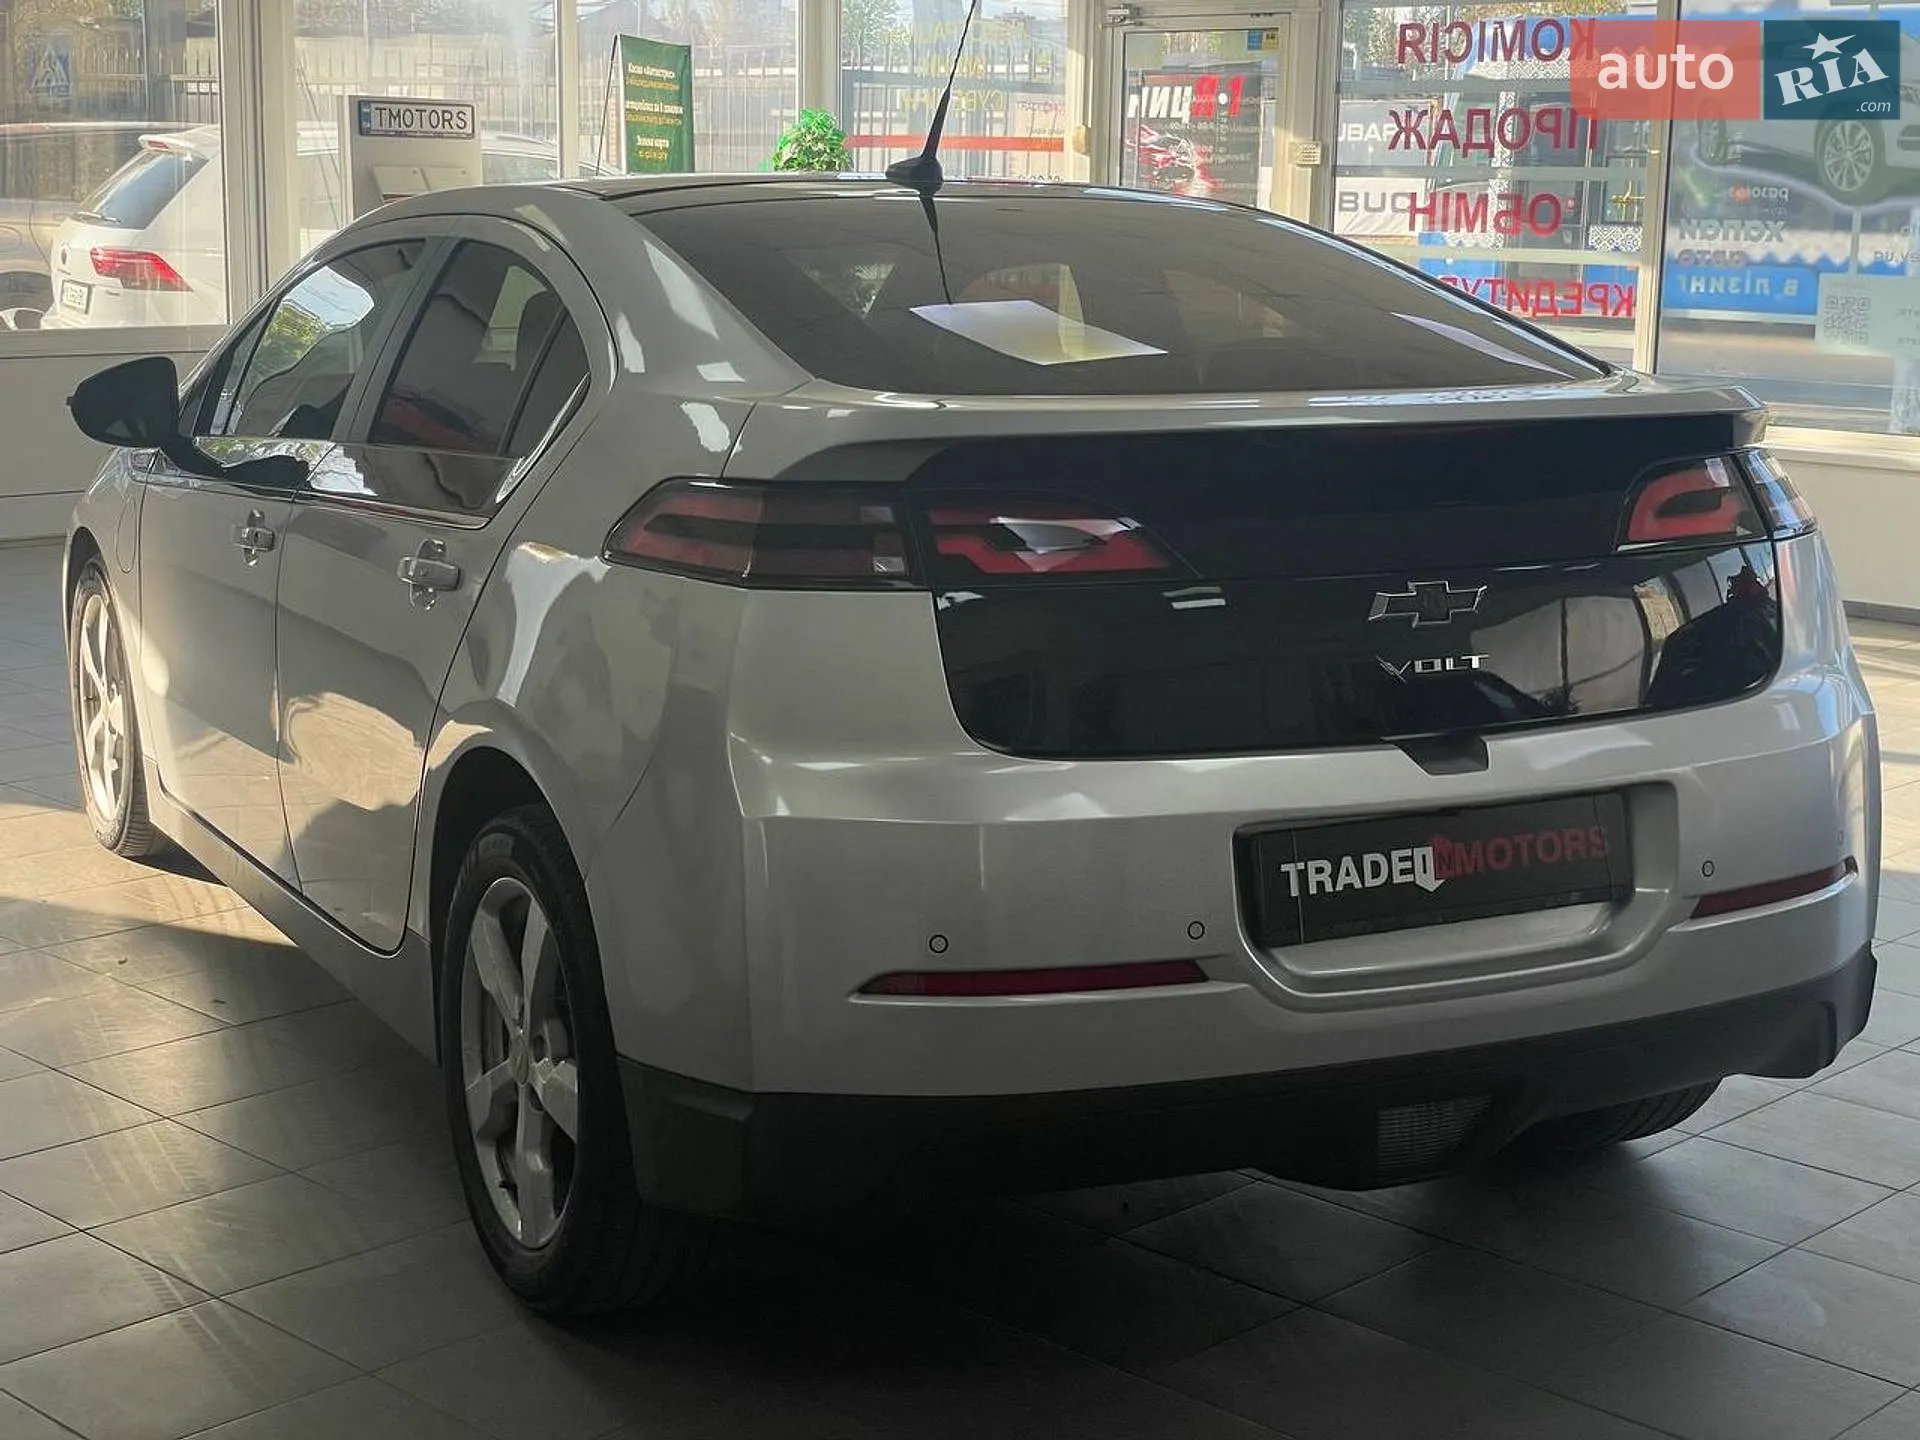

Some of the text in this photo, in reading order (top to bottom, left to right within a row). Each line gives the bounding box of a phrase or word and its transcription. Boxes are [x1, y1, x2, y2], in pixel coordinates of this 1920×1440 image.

[375, 107, 467, 129] TMOTORS
[1376, 655, 1490, 683] VOLT
[1281, 846, 1415, 897] TRADE
[1456, 826, 1608, 877] MOTORS
